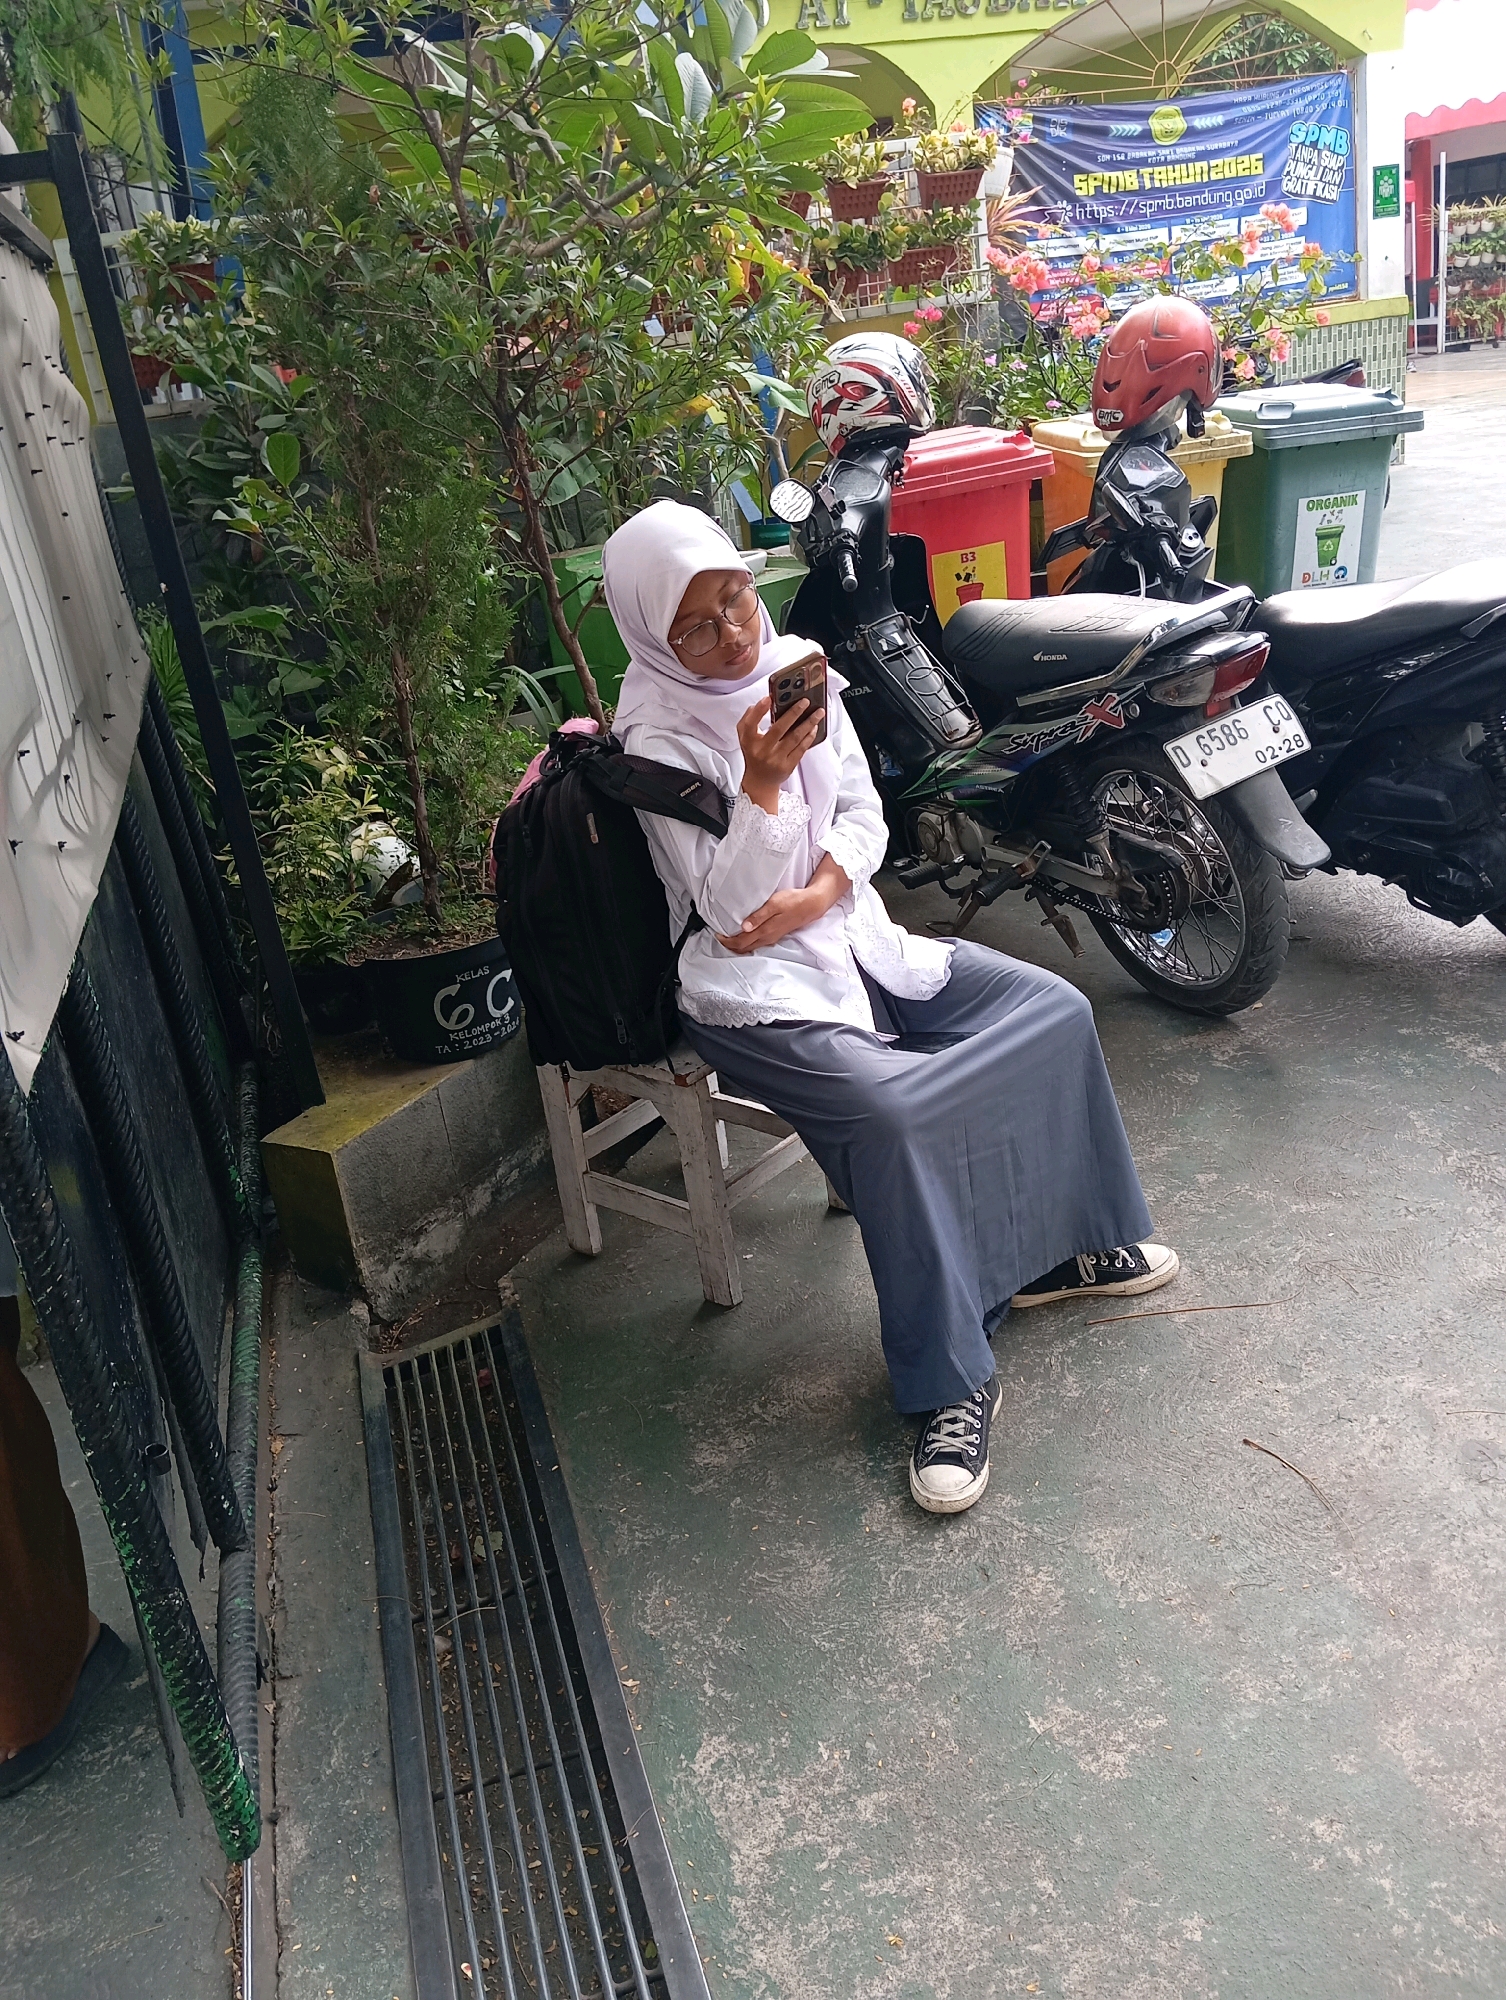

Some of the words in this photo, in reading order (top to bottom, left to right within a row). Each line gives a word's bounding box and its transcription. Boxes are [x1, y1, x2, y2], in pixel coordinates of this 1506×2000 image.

[1289, 121, 1349, 155] SPMB
[1288, 143, 1319, 166] TANPA
[1321, 150, 1344, 171] SUAP
[1073, 169, 1140, 197] SPMB
[1139, 161, 1209, 190] TAHUN
[1209, 153, 1265, 181] 2026
[1284, 160, 1324, 181] PUNGLI
[1322, 167, 1342, 185] DAN
[1075, 181, 1267, 224] https://spmb.bandung.go.id
[1306, 494, 1359, 512] ORGANIK
[960, 551, 977, 564] B3
[1302, 570, 1330, 584] DLH
[841, 685, 873, 699] ONDA
[1076, 692, 1126, 745] X
[1171, 745, 1192, 769] D
[1195, 718, 1249, 756] 6586
[455, 965, 490, 983] KELAS
[486, 968, 515, 1018] C
[448, 1017, 502, 1042] KELOMPOK
[503, 1012, 511, 1024] 3
[463, 1033, 493, 1050] 2023
